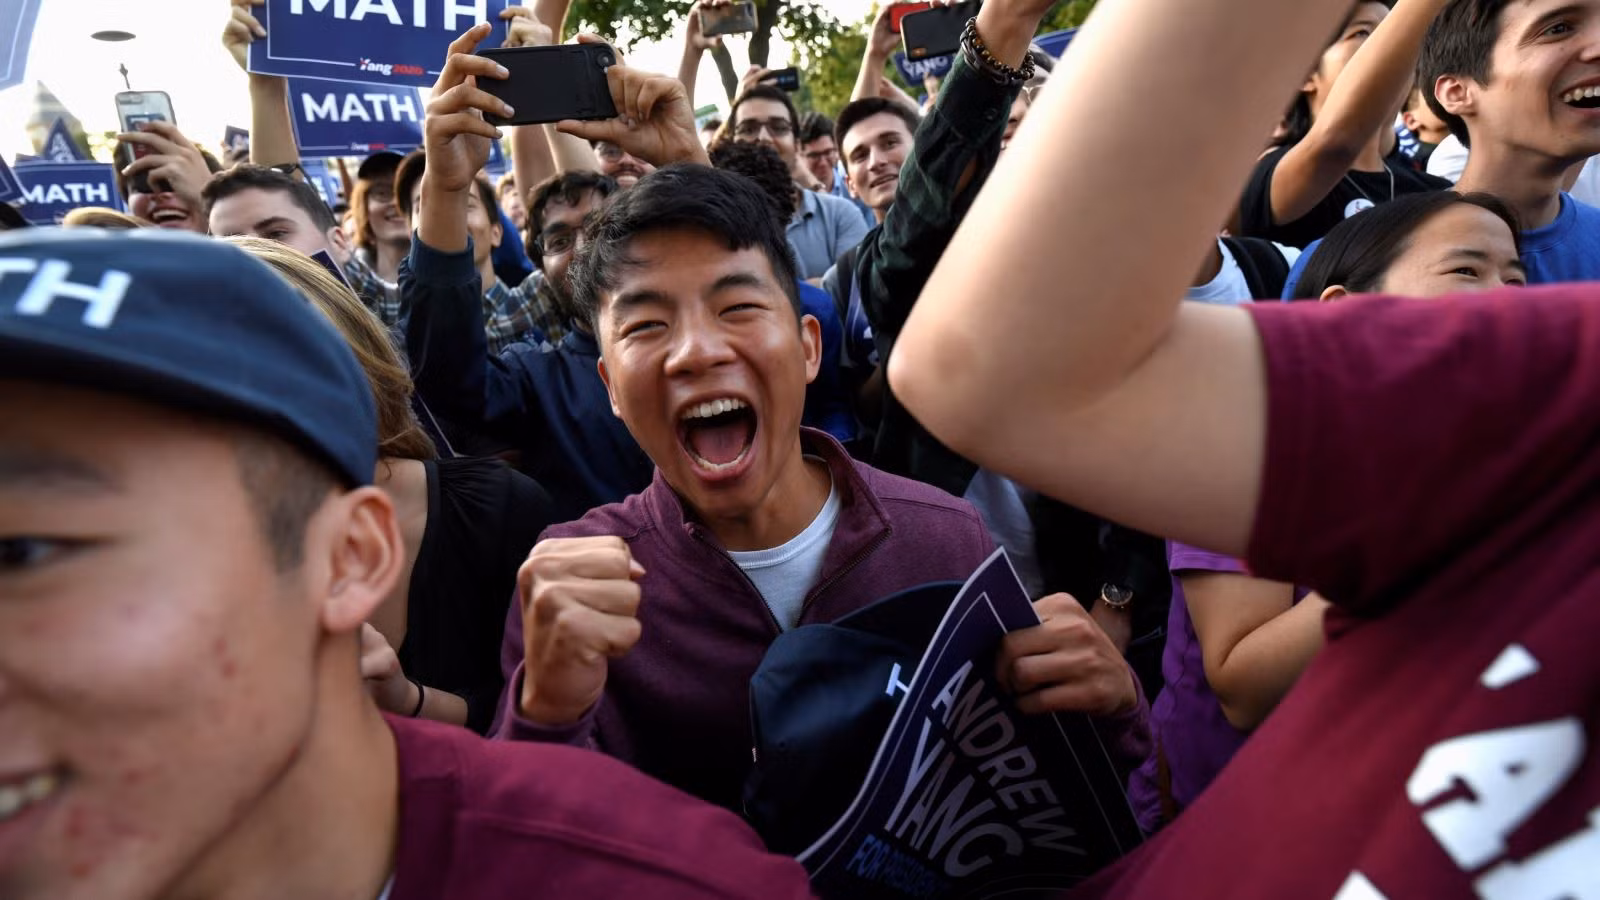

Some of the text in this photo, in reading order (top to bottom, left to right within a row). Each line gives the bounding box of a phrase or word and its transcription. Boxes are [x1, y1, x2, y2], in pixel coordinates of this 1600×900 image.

[301, 92, 418, 122] MATH
[18, 183, 109, 204] MATH
[931, 659, 1089, 857] ANDREW
[884, 715, 1025, 878] YANG
[845, 833, 892, 881] FOR
